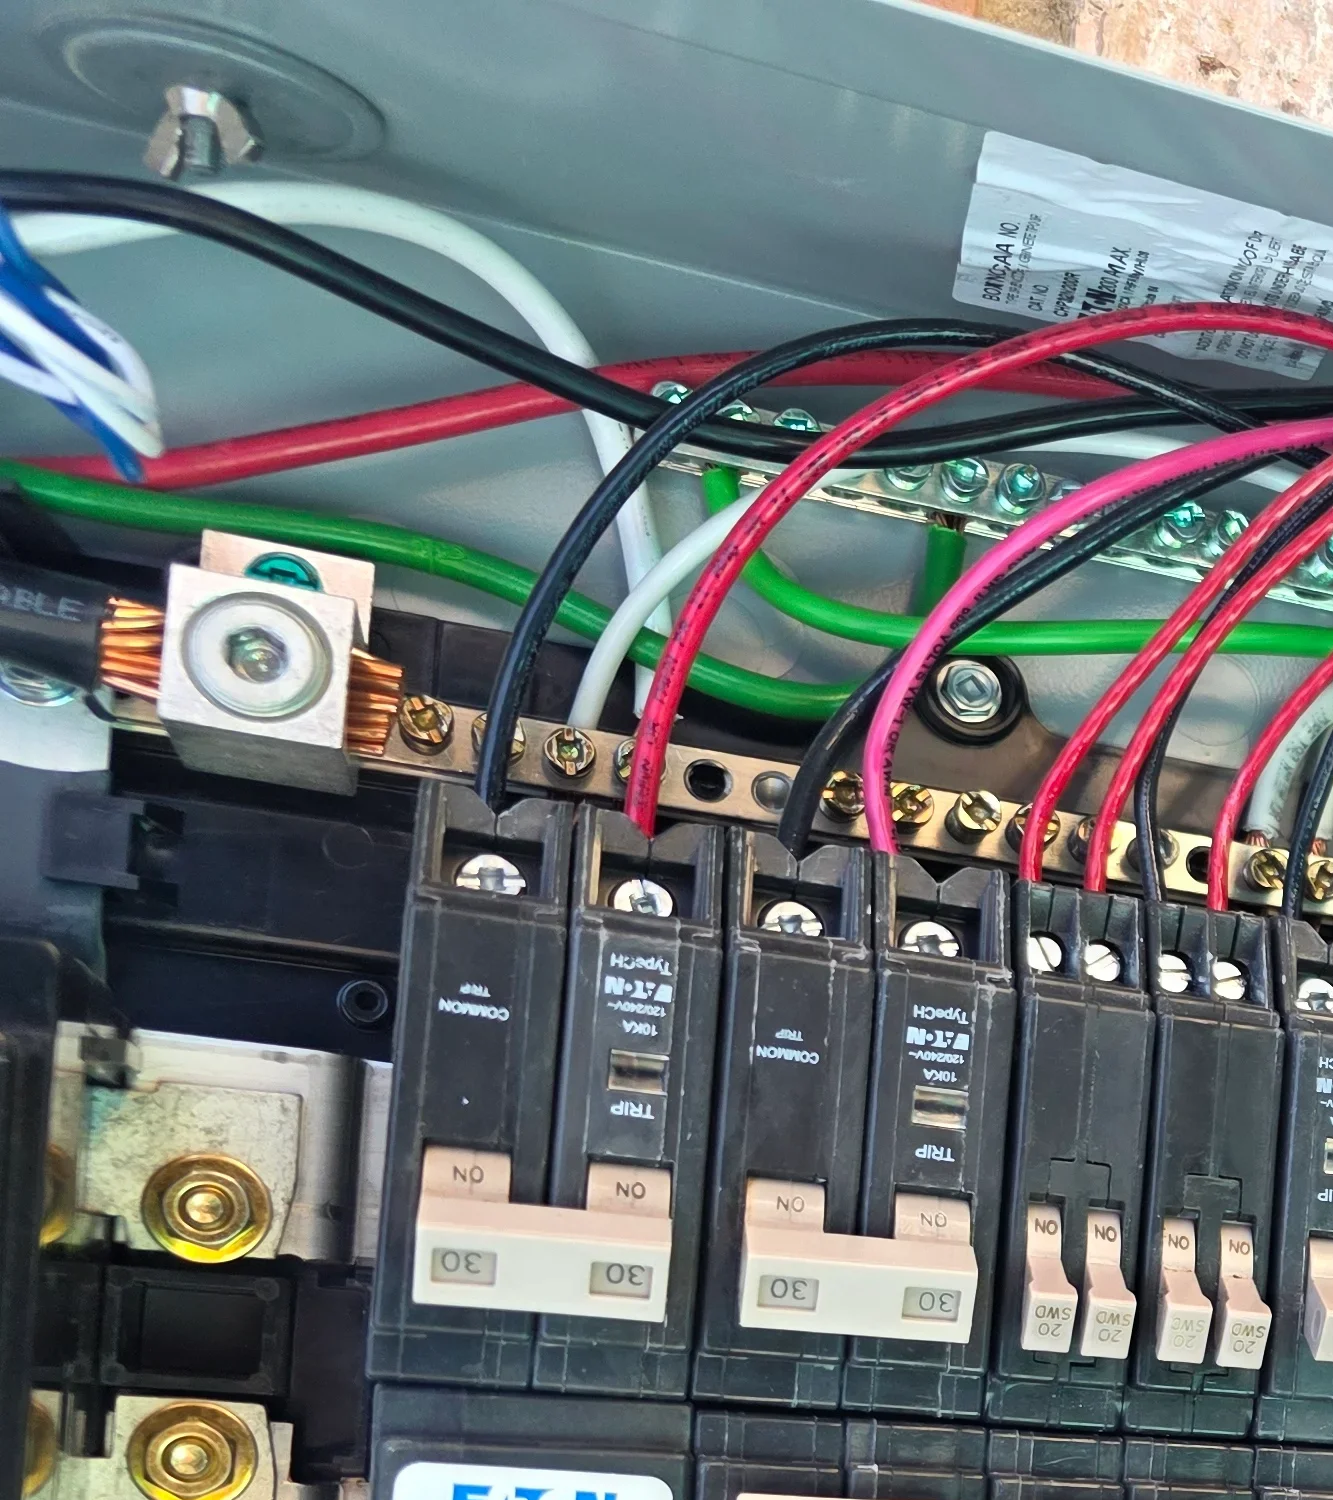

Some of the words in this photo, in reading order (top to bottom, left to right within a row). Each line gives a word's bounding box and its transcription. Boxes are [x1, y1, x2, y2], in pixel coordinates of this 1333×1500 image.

[604, 976, 672, 1002] EATON
[438, 998, 509, 1021] COMMON
[622, 1020, 657, 1036] 10KA
[906, 1027, 969, 1050] EATON
[756, 1045, 820, 1064] COMMON
[610, 1101, 654, 1119] TRIP
[916, 1145, 955, 1161] TRIP
[453, 1164, 484, 1184] ON
[616, 1181, 646, 1200] ON
[776, 1195, 805, 1213] ON
[920, 1210, 947, 1227] ON
[441, 1251, 482, 1274] 30
[606, 1263, 645, 1286] 30
[771, 1278, 808, 1299] 30
[919, 1291, 954, 1312] 30
